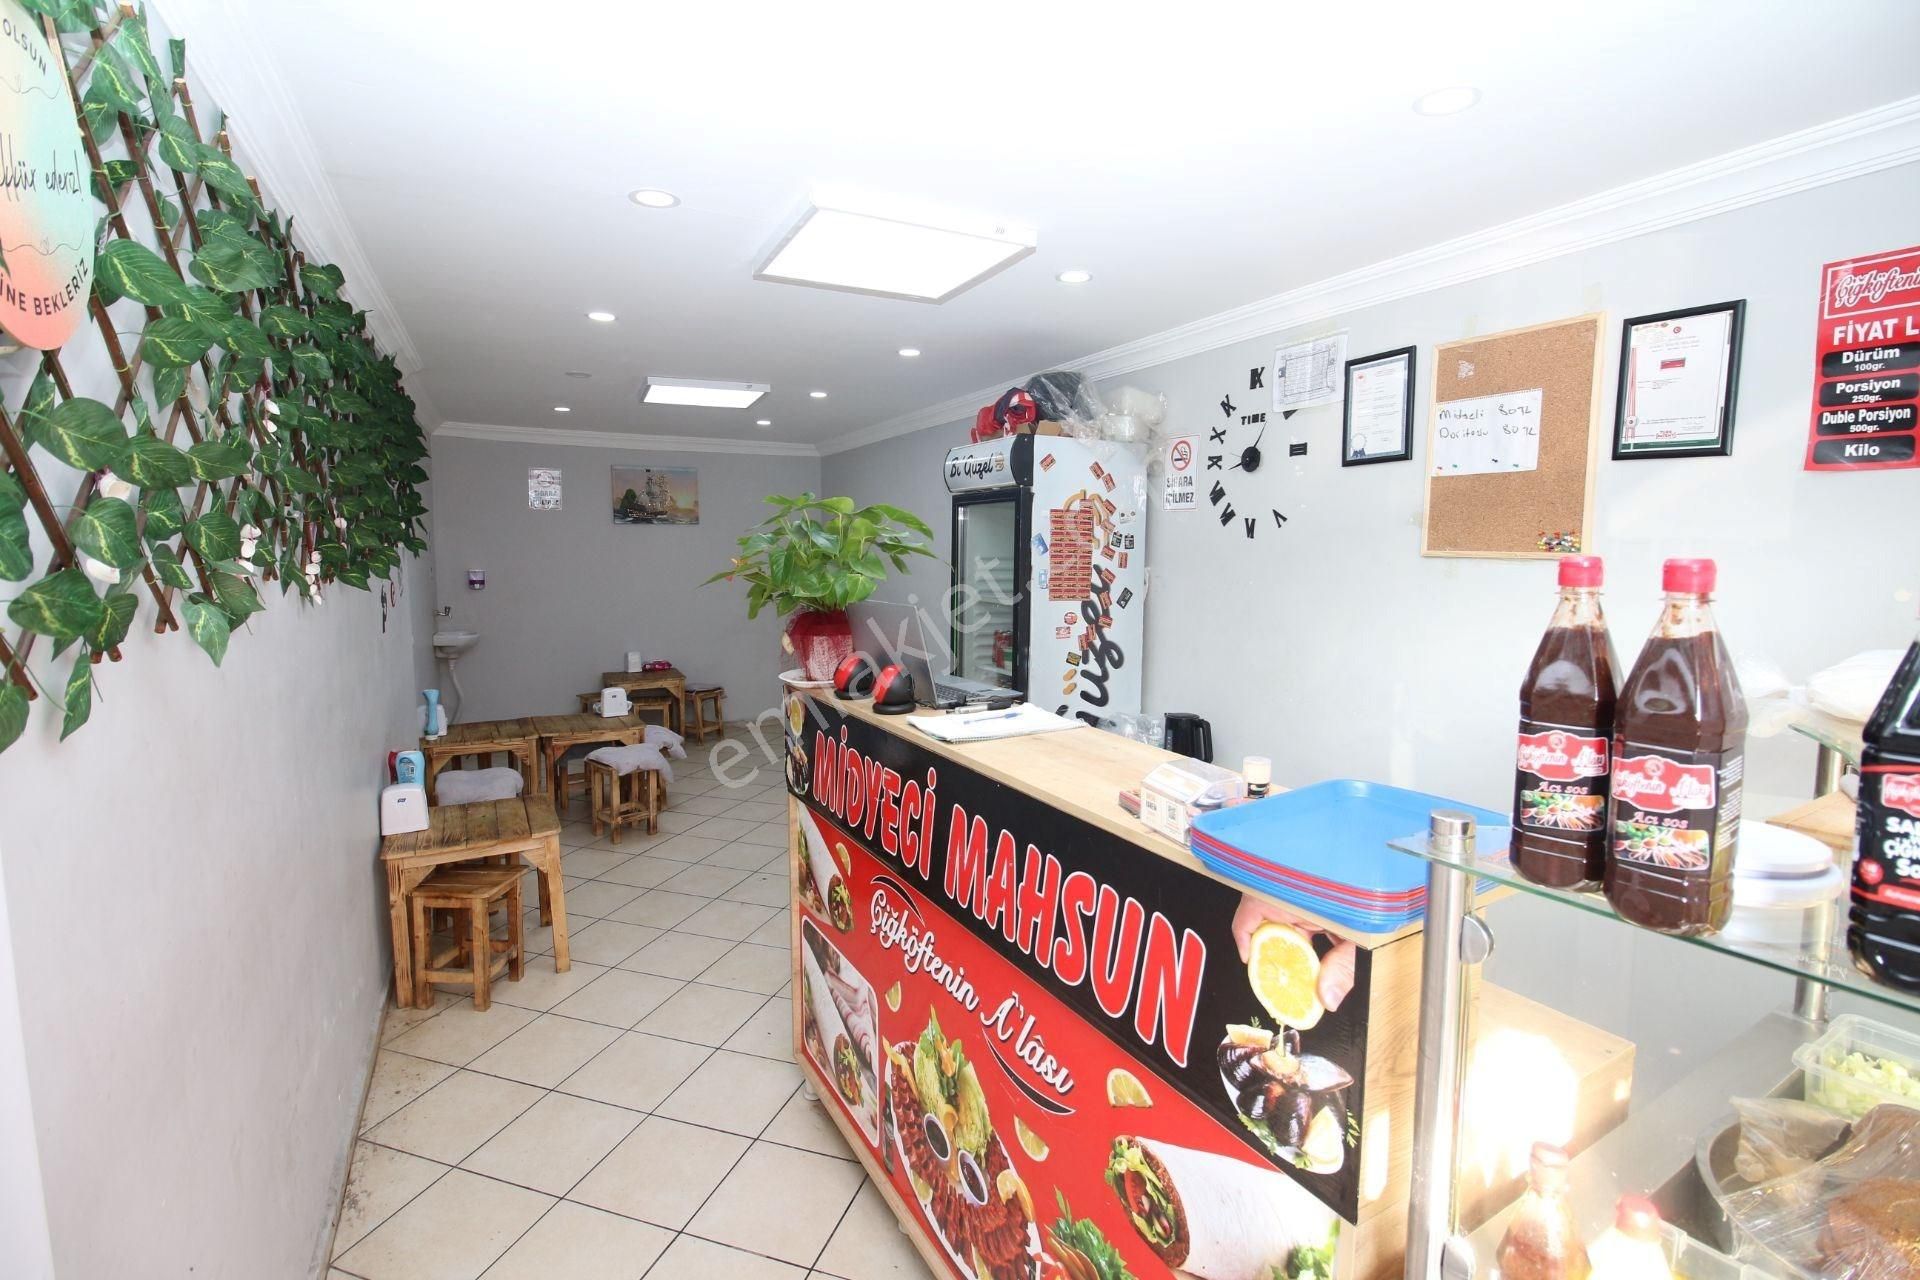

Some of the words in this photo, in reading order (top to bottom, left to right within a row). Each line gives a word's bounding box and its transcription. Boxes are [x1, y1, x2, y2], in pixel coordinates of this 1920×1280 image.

[3, 18, 47, 76] OLSUN
[33, 257, 89, 316] BEKLERİZ
[1833, 320, 1899, 345] FİYAT
[1842, 348, 1901, 364] Dürüm
[1854, 362, 1886, 372] 100gr.
[1836, 379, 1901, 394] Porsiyon
[1851, 394, 1882, 404] 250gr.
[1240, 412, 1266, 426] TIME
[1822, 410, 1856, 425] Duble
[1858, 407, 1911, 423] Porsiyon
[1849, 424, 1880, 434] 500gr.
[1844, 443, 1880, 457] Kilo
[813, 724, 937, 881] MİDYECİ
[944, 803, 1207, 1068] MAHSUN
[870, 889, 980, 1012] Çiğköftenin
